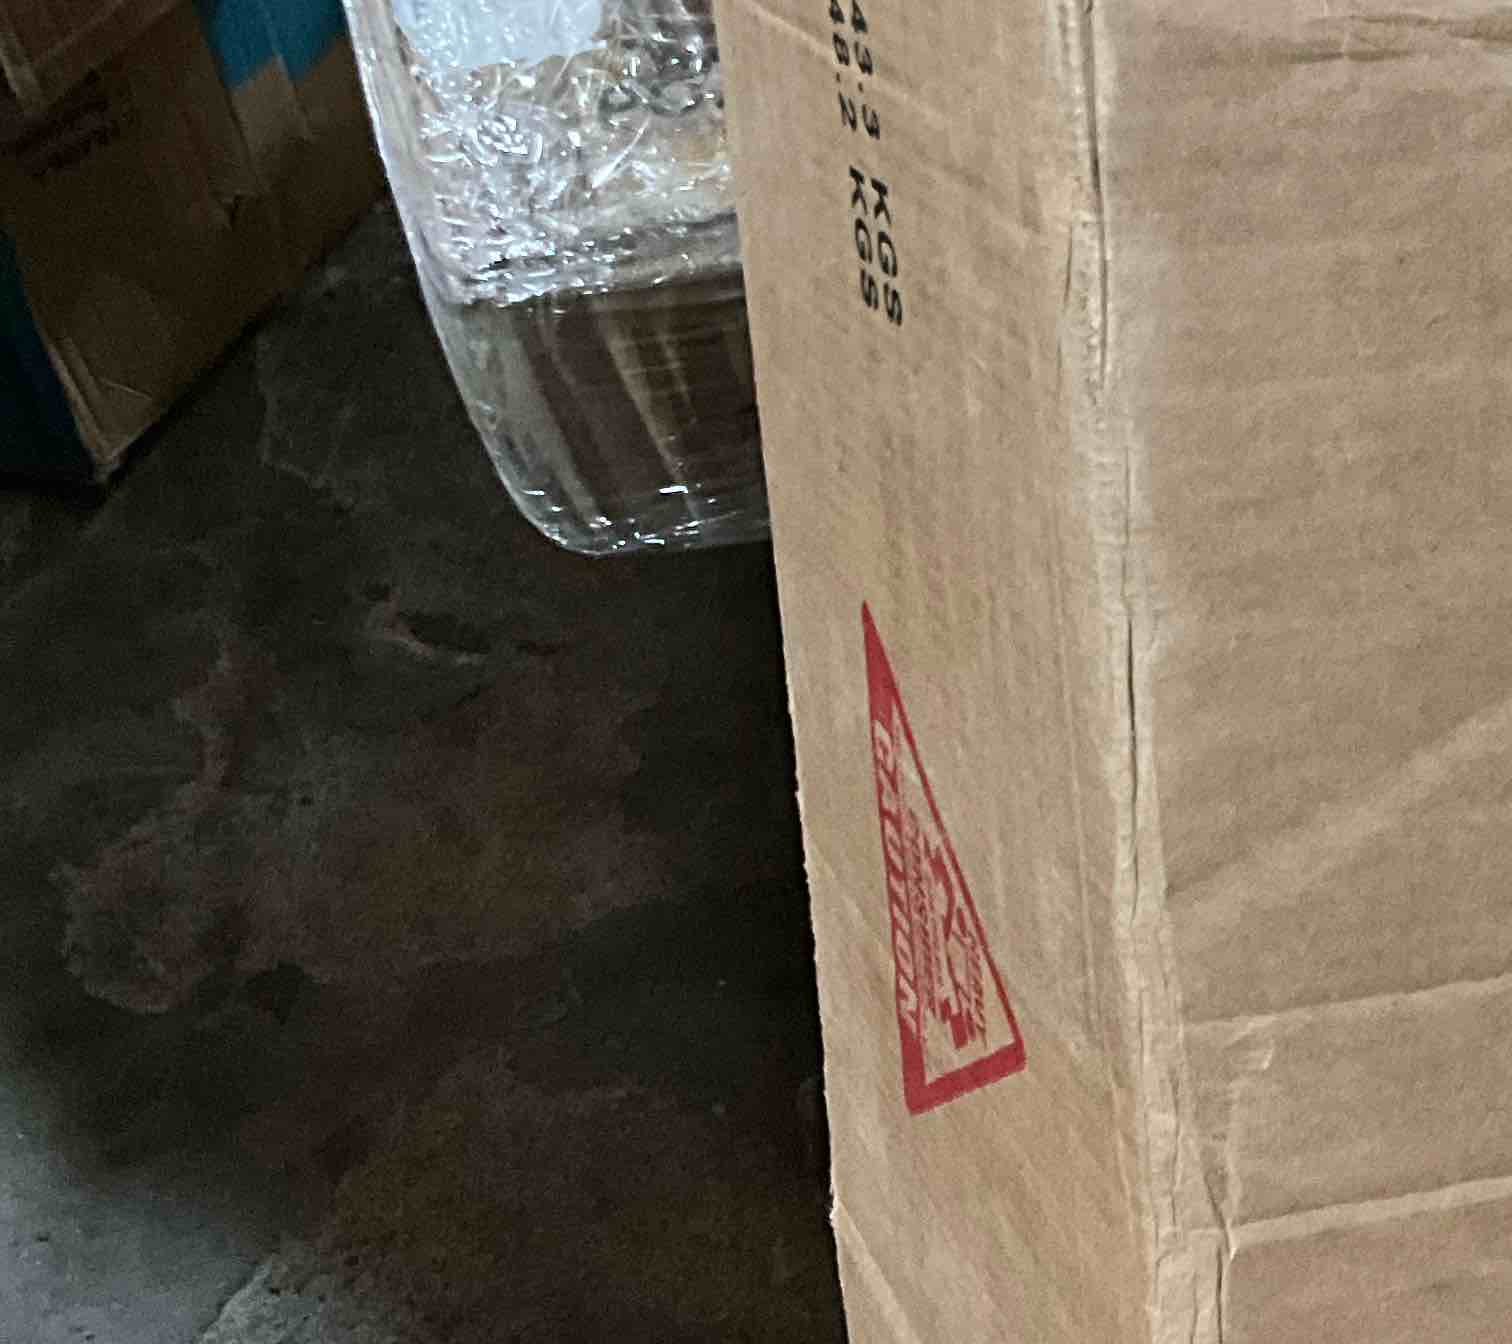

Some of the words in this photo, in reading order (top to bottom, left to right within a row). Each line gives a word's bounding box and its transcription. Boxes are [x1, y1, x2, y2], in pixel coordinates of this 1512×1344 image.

[849, 164, 879, 313] KGS
[871, 176, 903, 327] KGS
[872, 715, 920, 1038] CAUTION
